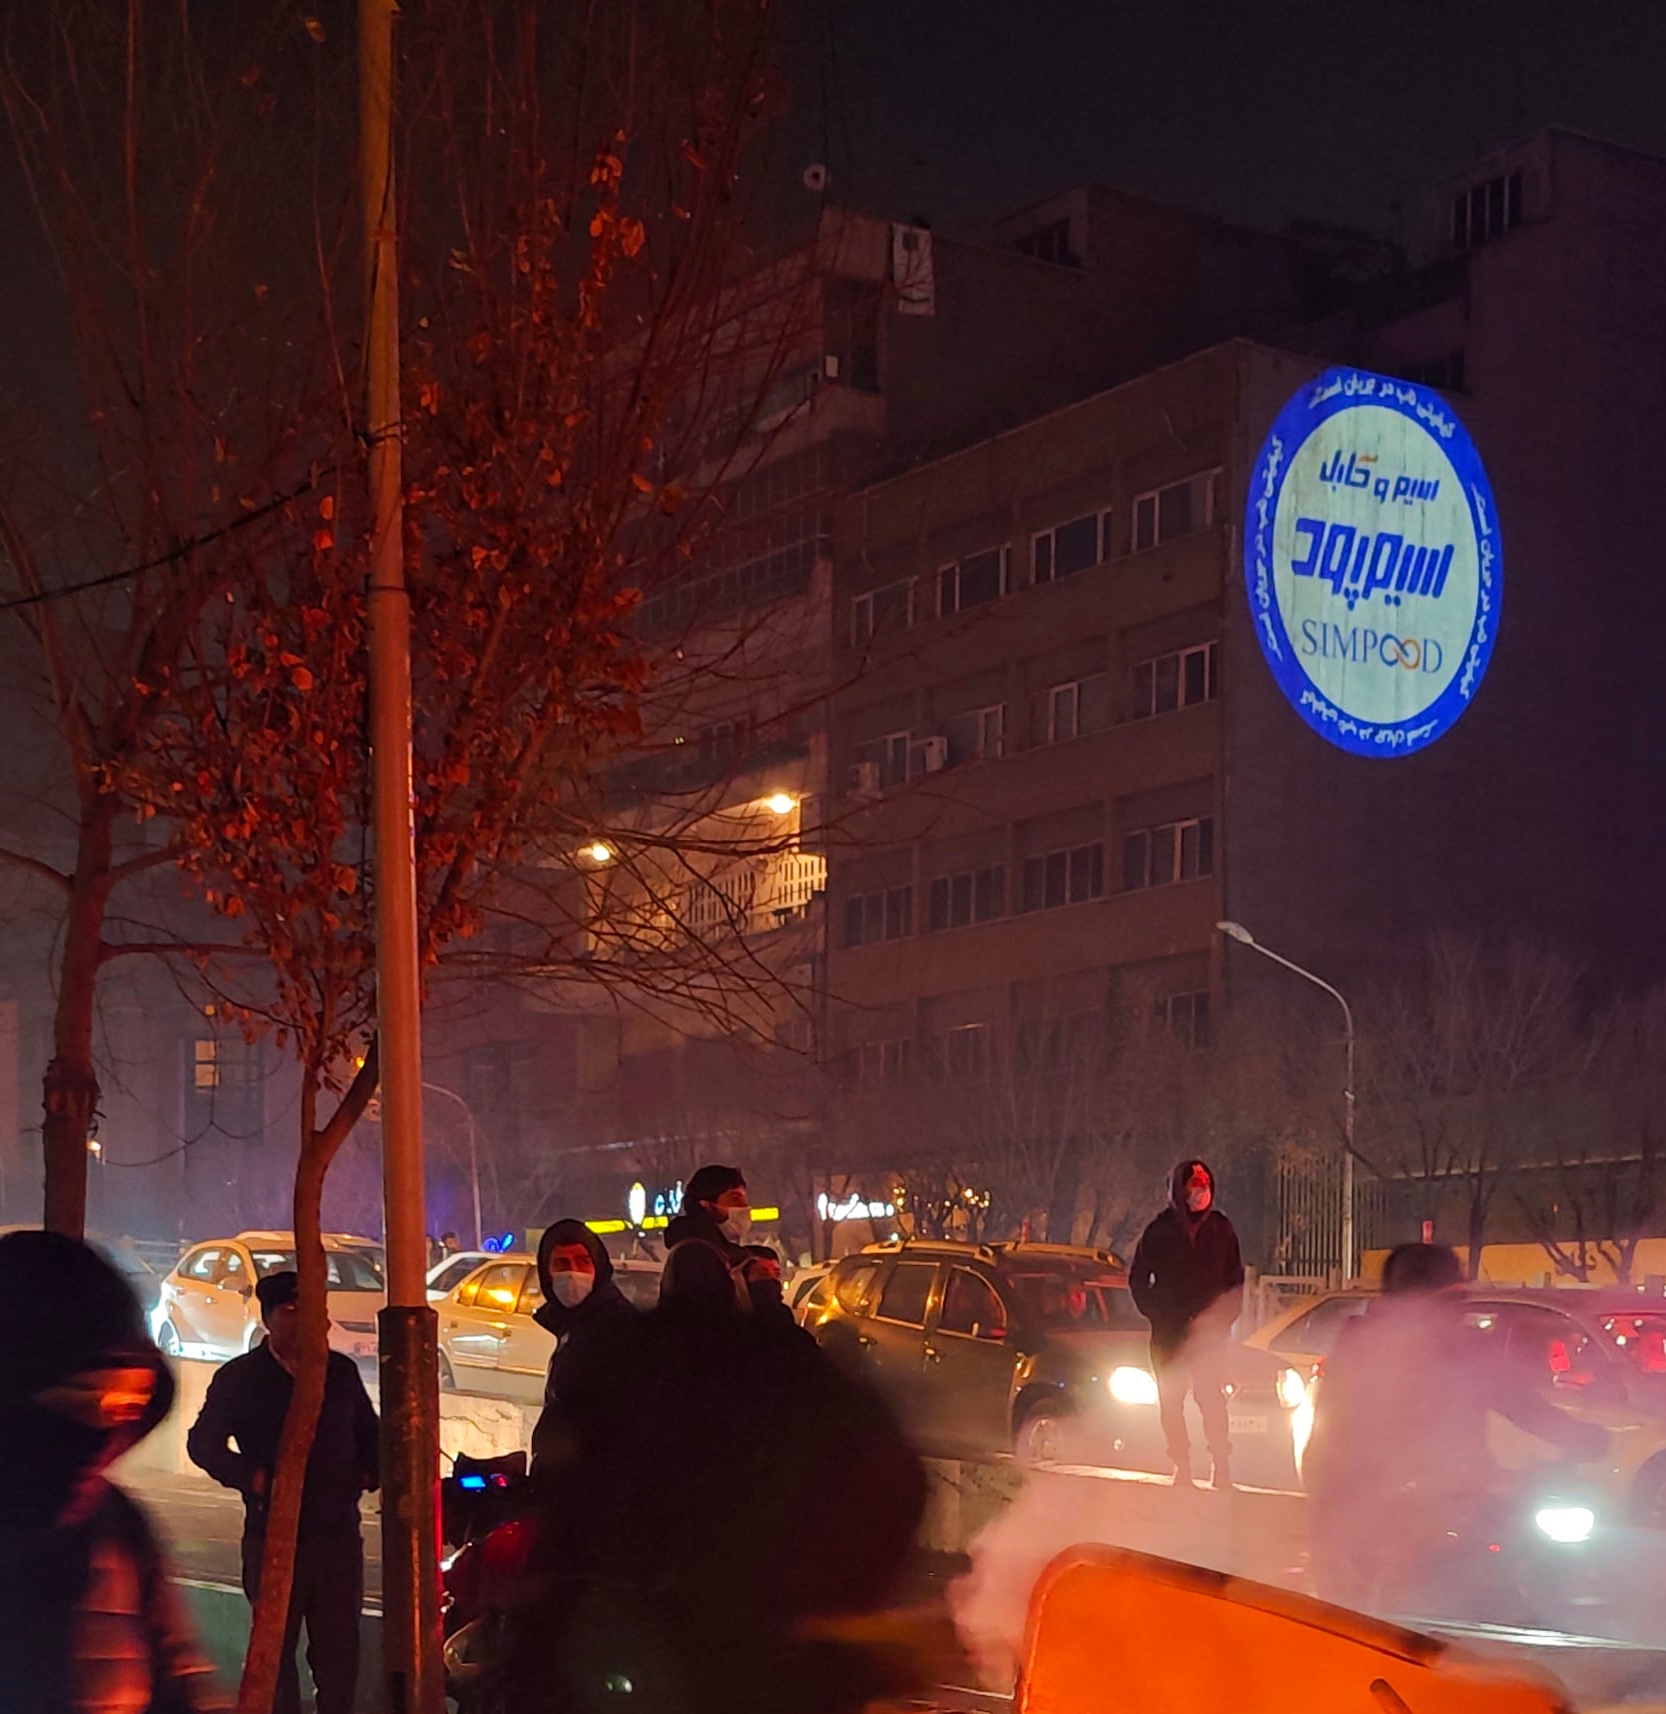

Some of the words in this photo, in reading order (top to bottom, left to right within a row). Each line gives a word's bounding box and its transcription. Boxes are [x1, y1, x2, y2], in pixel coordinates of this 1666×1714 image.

[1319, 449, 1379, 493] کابل
[1373, 477, 1391, 504] و
[1392, 476, 1440, 506] سیم
[1301, 619, 1443, 674] SIMPOOD
